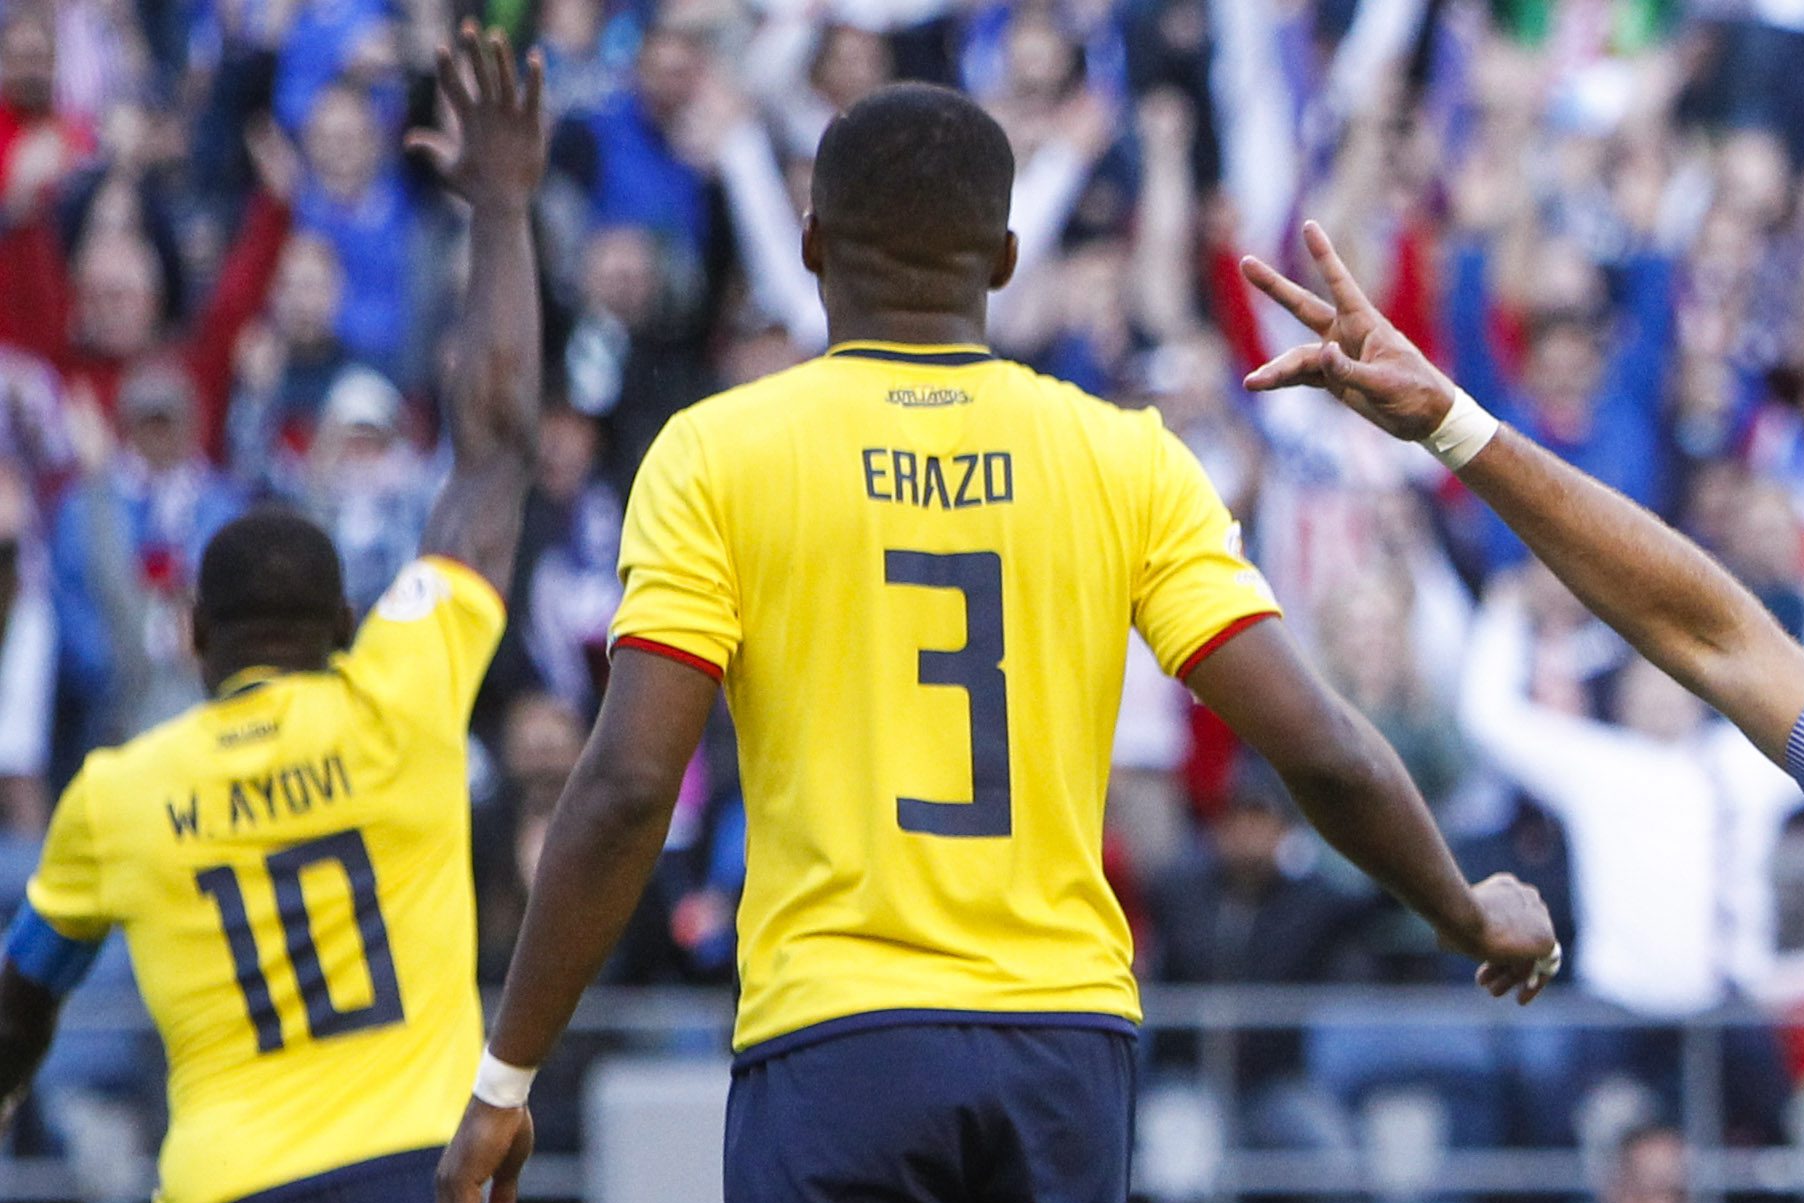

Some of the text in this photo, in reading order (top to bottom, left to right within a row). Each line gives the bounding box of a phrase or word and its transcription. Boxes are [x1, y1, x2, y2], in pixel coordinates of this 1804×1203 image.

[862, 448, 1013, 510] ERAZO
[884, 549, 1011, 837] 3
[231, 755, 352, 827] AYOVI
[196, 828, 406, 1053] 10
